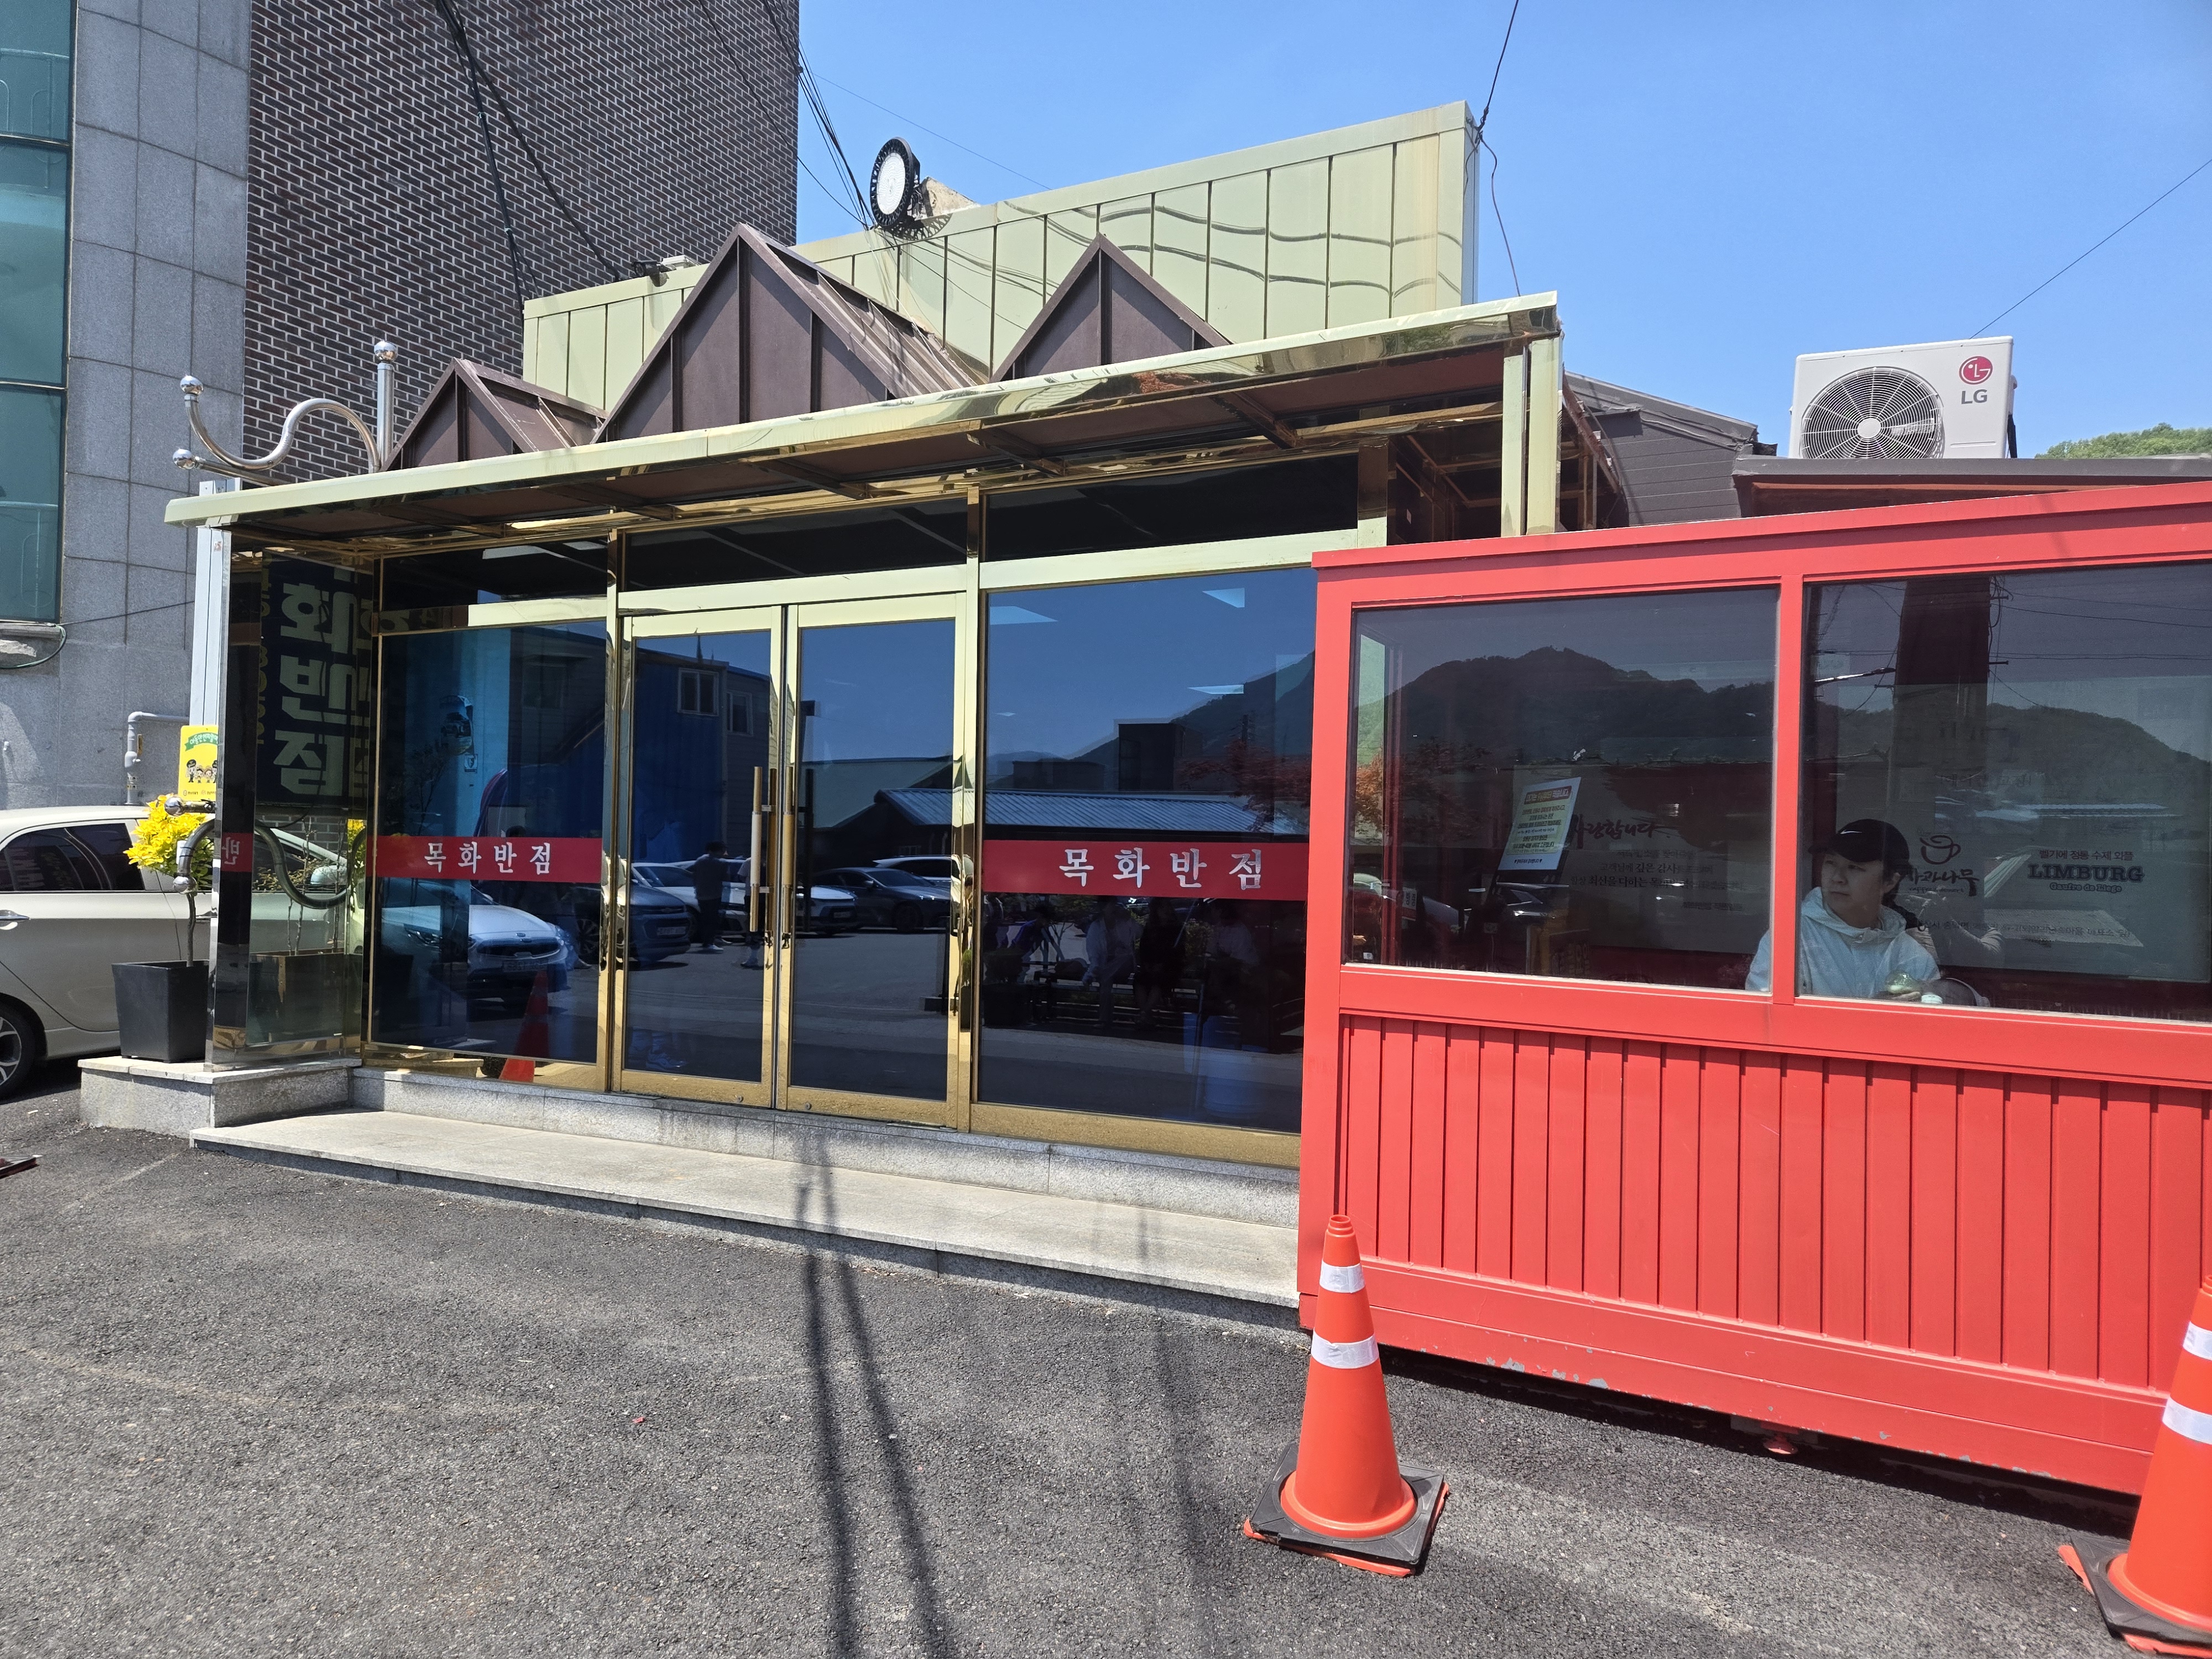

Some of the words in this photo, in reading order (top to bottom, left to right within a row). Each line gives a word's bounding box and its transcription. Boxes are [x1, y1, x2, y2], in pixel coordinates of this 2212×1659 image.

[1961, 389, 1987, 404] LG
[424, 842, 551, 874] 목화반점
[2040, 850, 2068, 859] 벨기에
[2070, 850, 2090, 860] 정통
[2091, 851, 2111, 860] 수제
[2114, 851, 2134, 861] 와플
[1058, 847, 1263, 891] 목화반점
[2028, 863, 2145, 883] LIMBURG
[1589, 875, 1616, 886] 최선을
[2049, 882, 2083, 891] Gaufre
